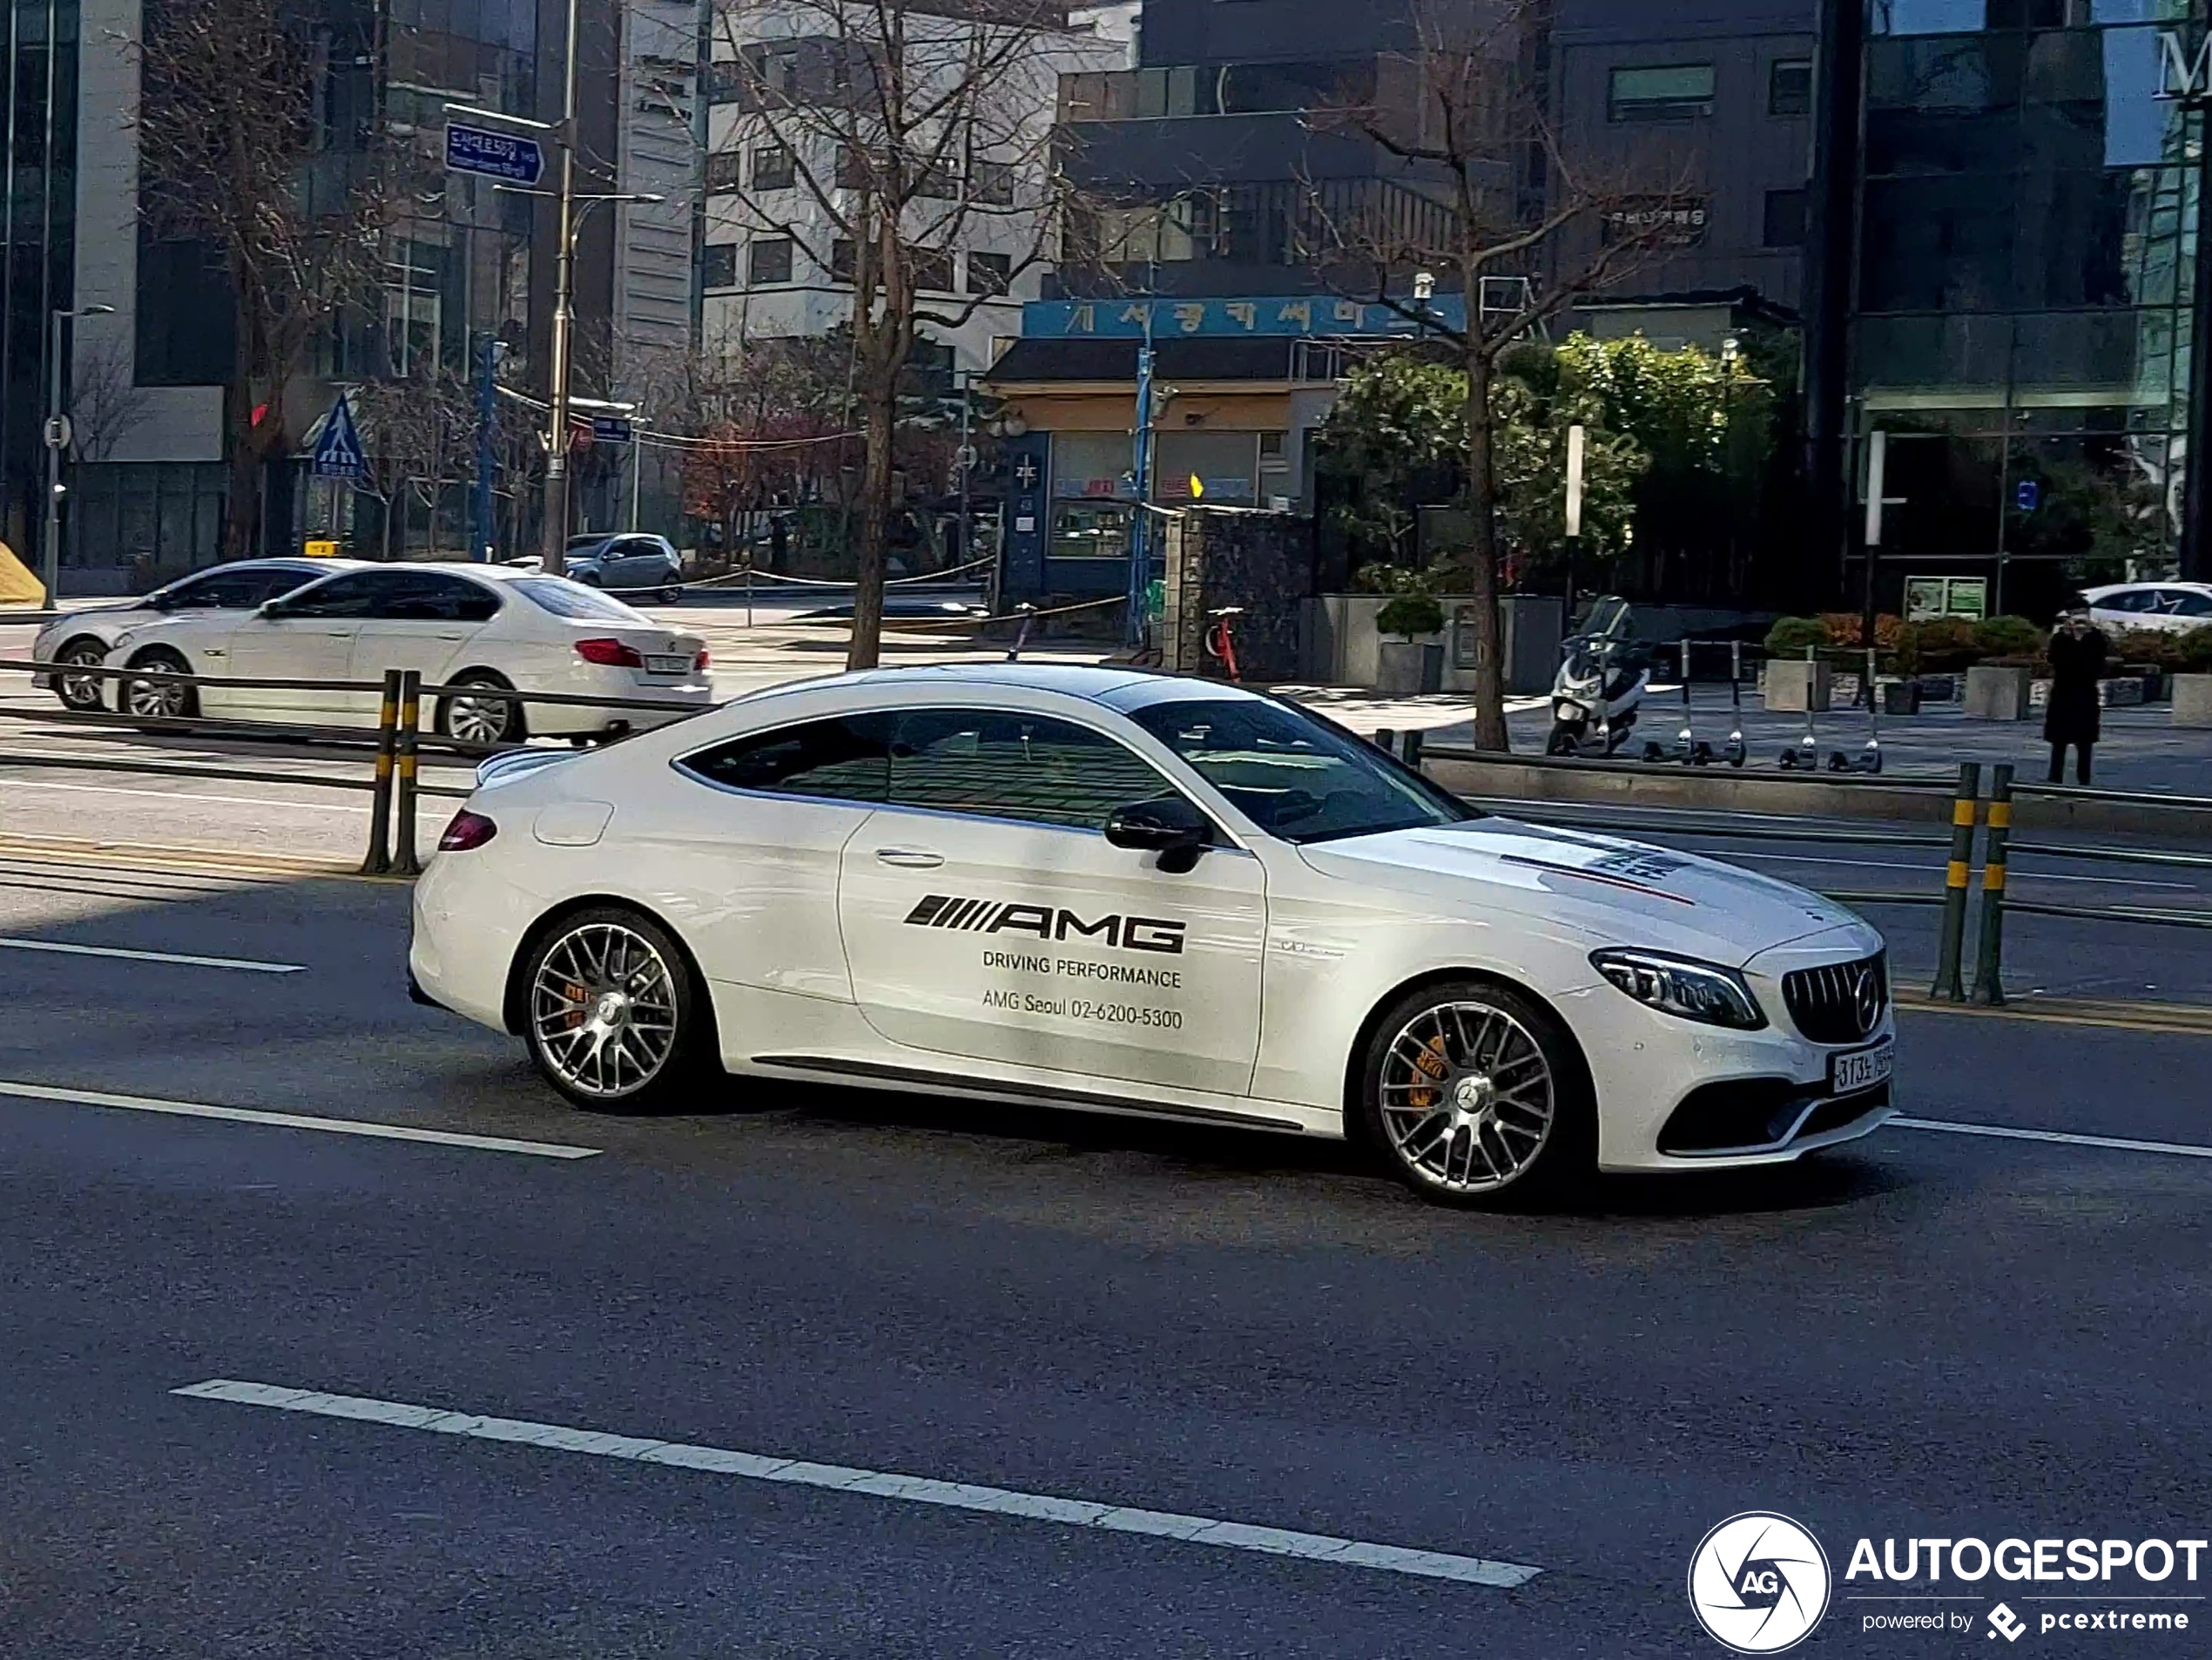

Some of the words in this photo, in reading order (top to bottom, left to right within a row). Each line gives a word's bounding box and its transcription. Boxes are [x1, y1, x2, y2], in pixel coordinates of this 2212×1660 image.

[982, 950, 1051, 974] DRIVING
[1056, 959, 1182, 989] PERFORMANCE
[981, 989, 1020, 1010] AMG
[1024, 993, 1067, 1016] Seoul
[1071, 1000, 1183, 1029] 02-6200-5300
